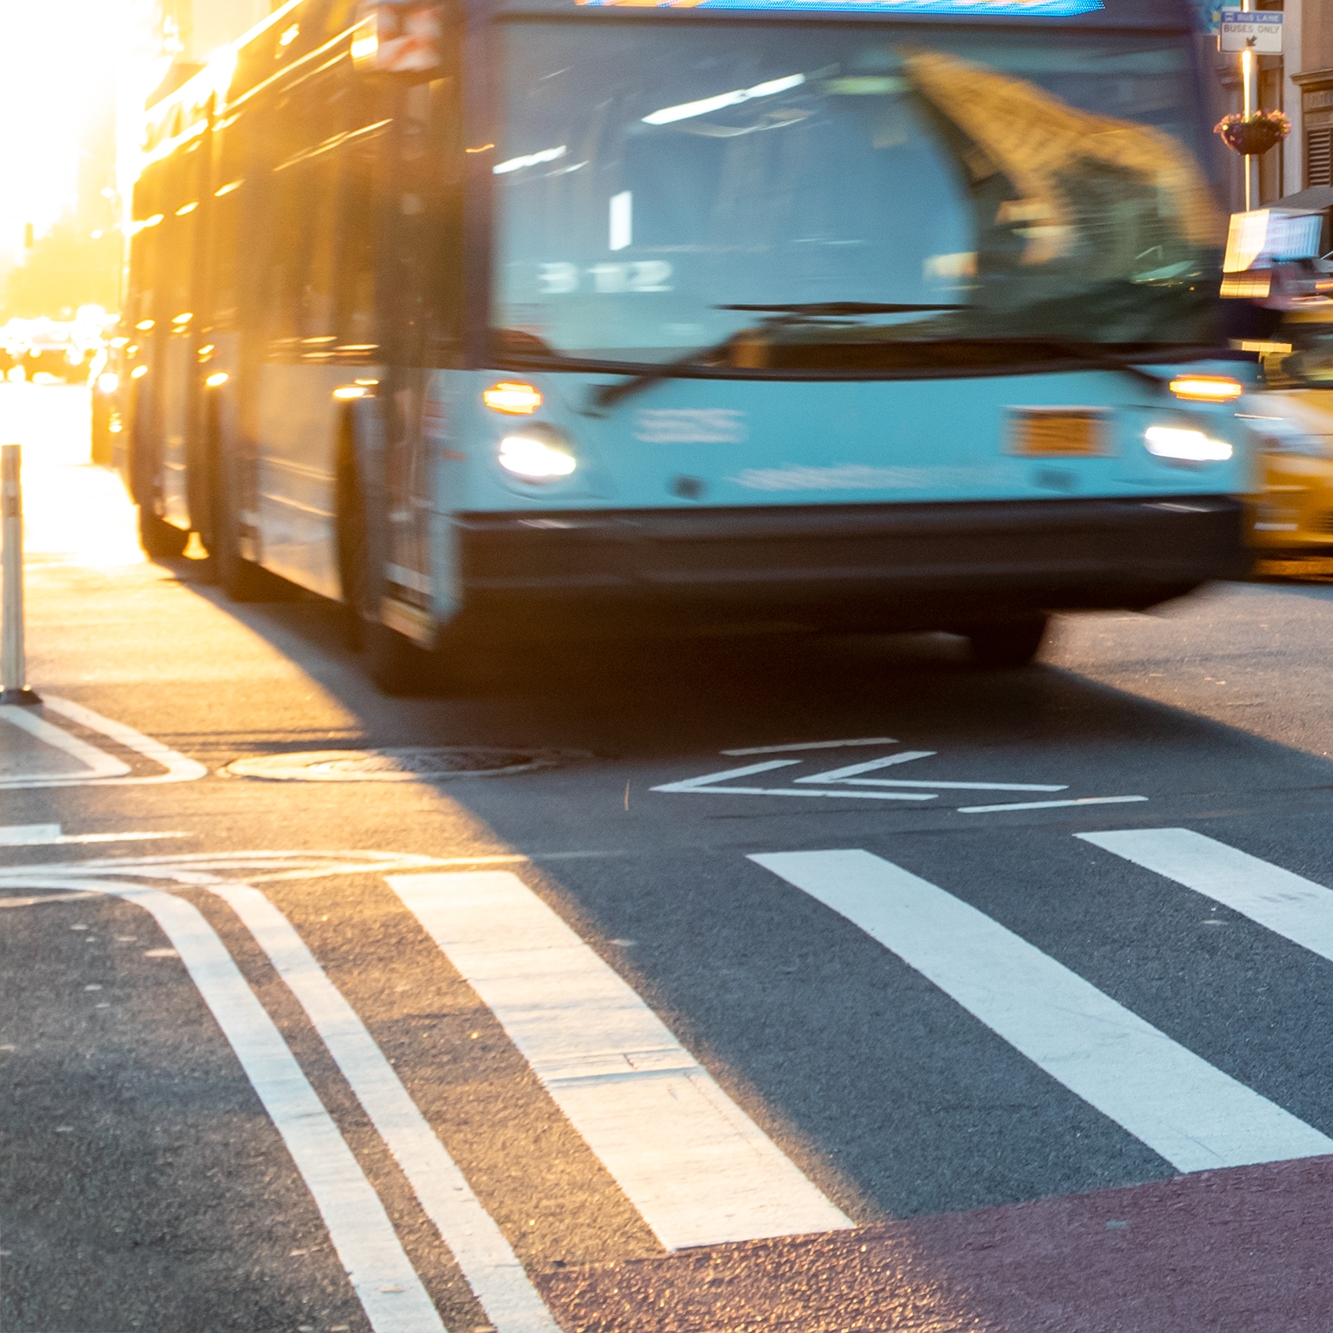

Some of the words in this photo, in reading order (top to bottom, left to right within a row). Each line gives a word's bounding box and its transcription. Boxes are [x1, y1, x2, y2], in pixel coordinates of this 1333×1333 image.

[1236, 13, 1254, 22] BUS
[1256, 14, 1280, 22] LANE
[1223, 24, 1253, 33] BUSES
[1257, 25, 1280, 34] ONLY
